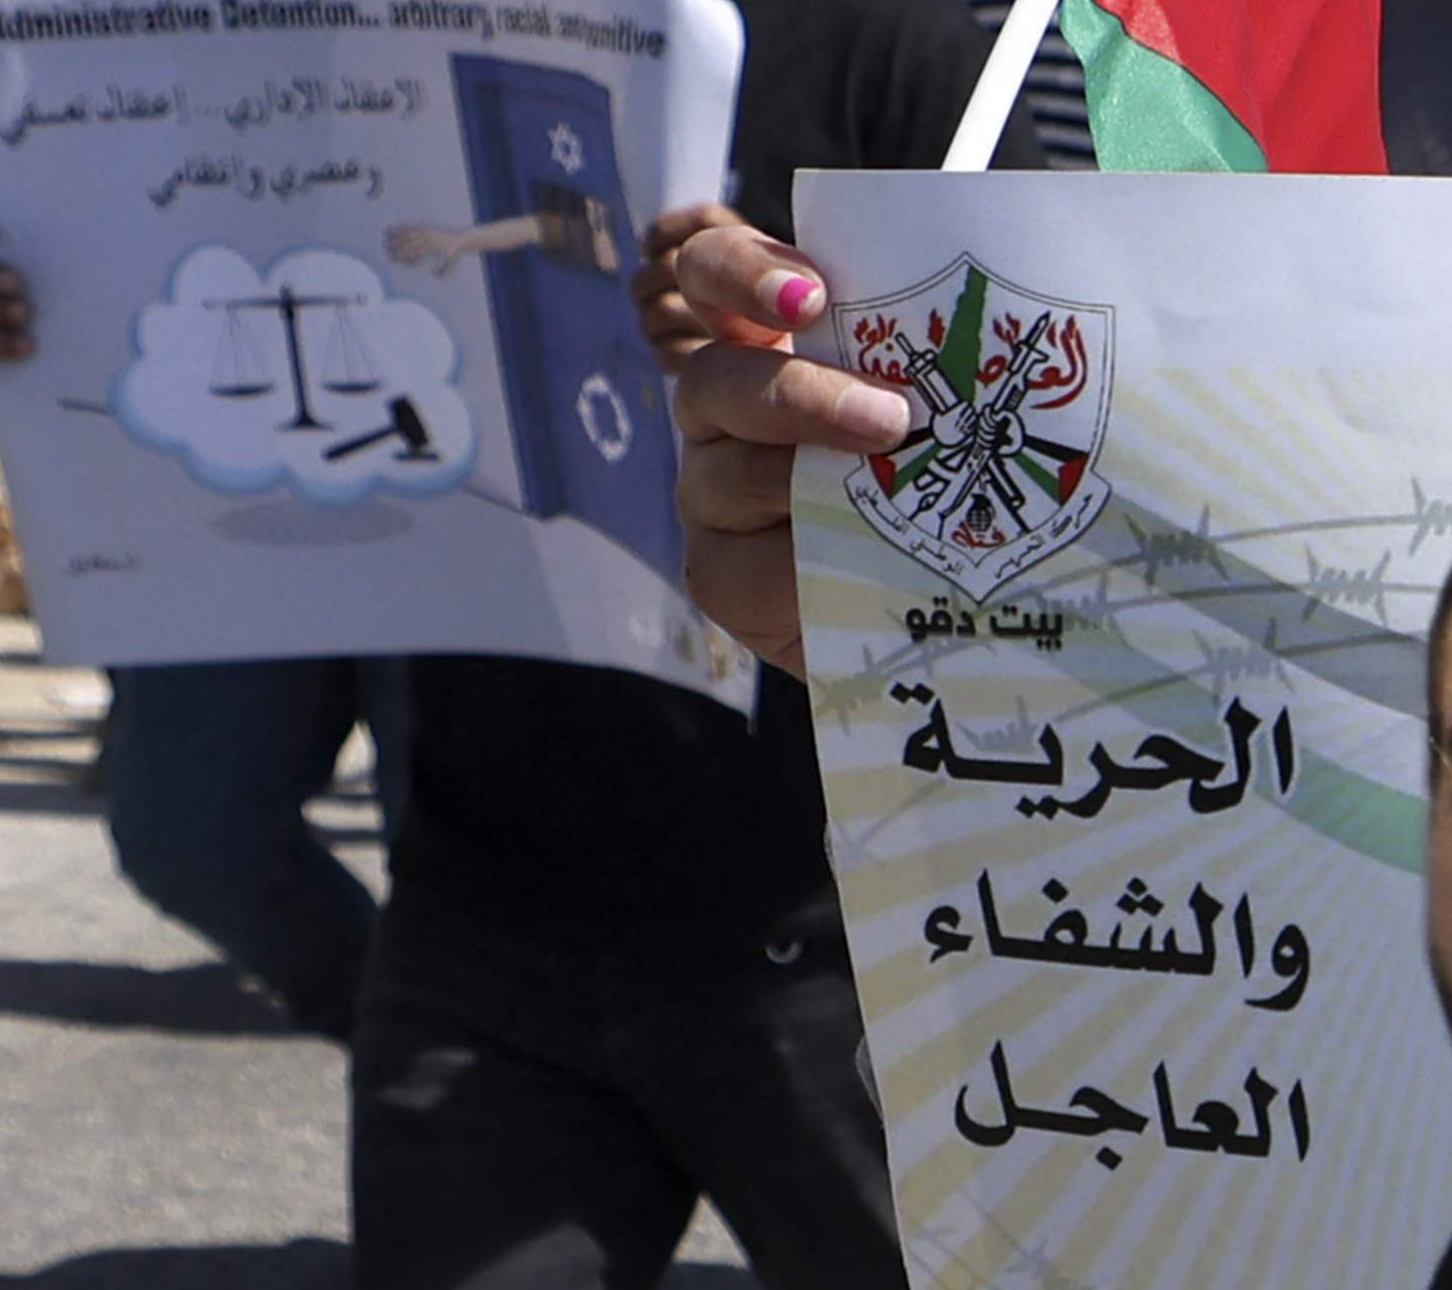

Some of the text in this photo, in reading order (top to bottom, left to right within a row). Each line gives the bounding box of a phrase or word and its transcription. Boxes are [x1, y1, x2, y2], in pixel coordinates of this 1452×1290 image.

[905, 597, 1064, 651] بيت دقو
[888, 681, 1295, 820] الحرية
[922, 868, 1311, 1011] والشفاء
[954, 1040, 1310, 1169] العاجل
